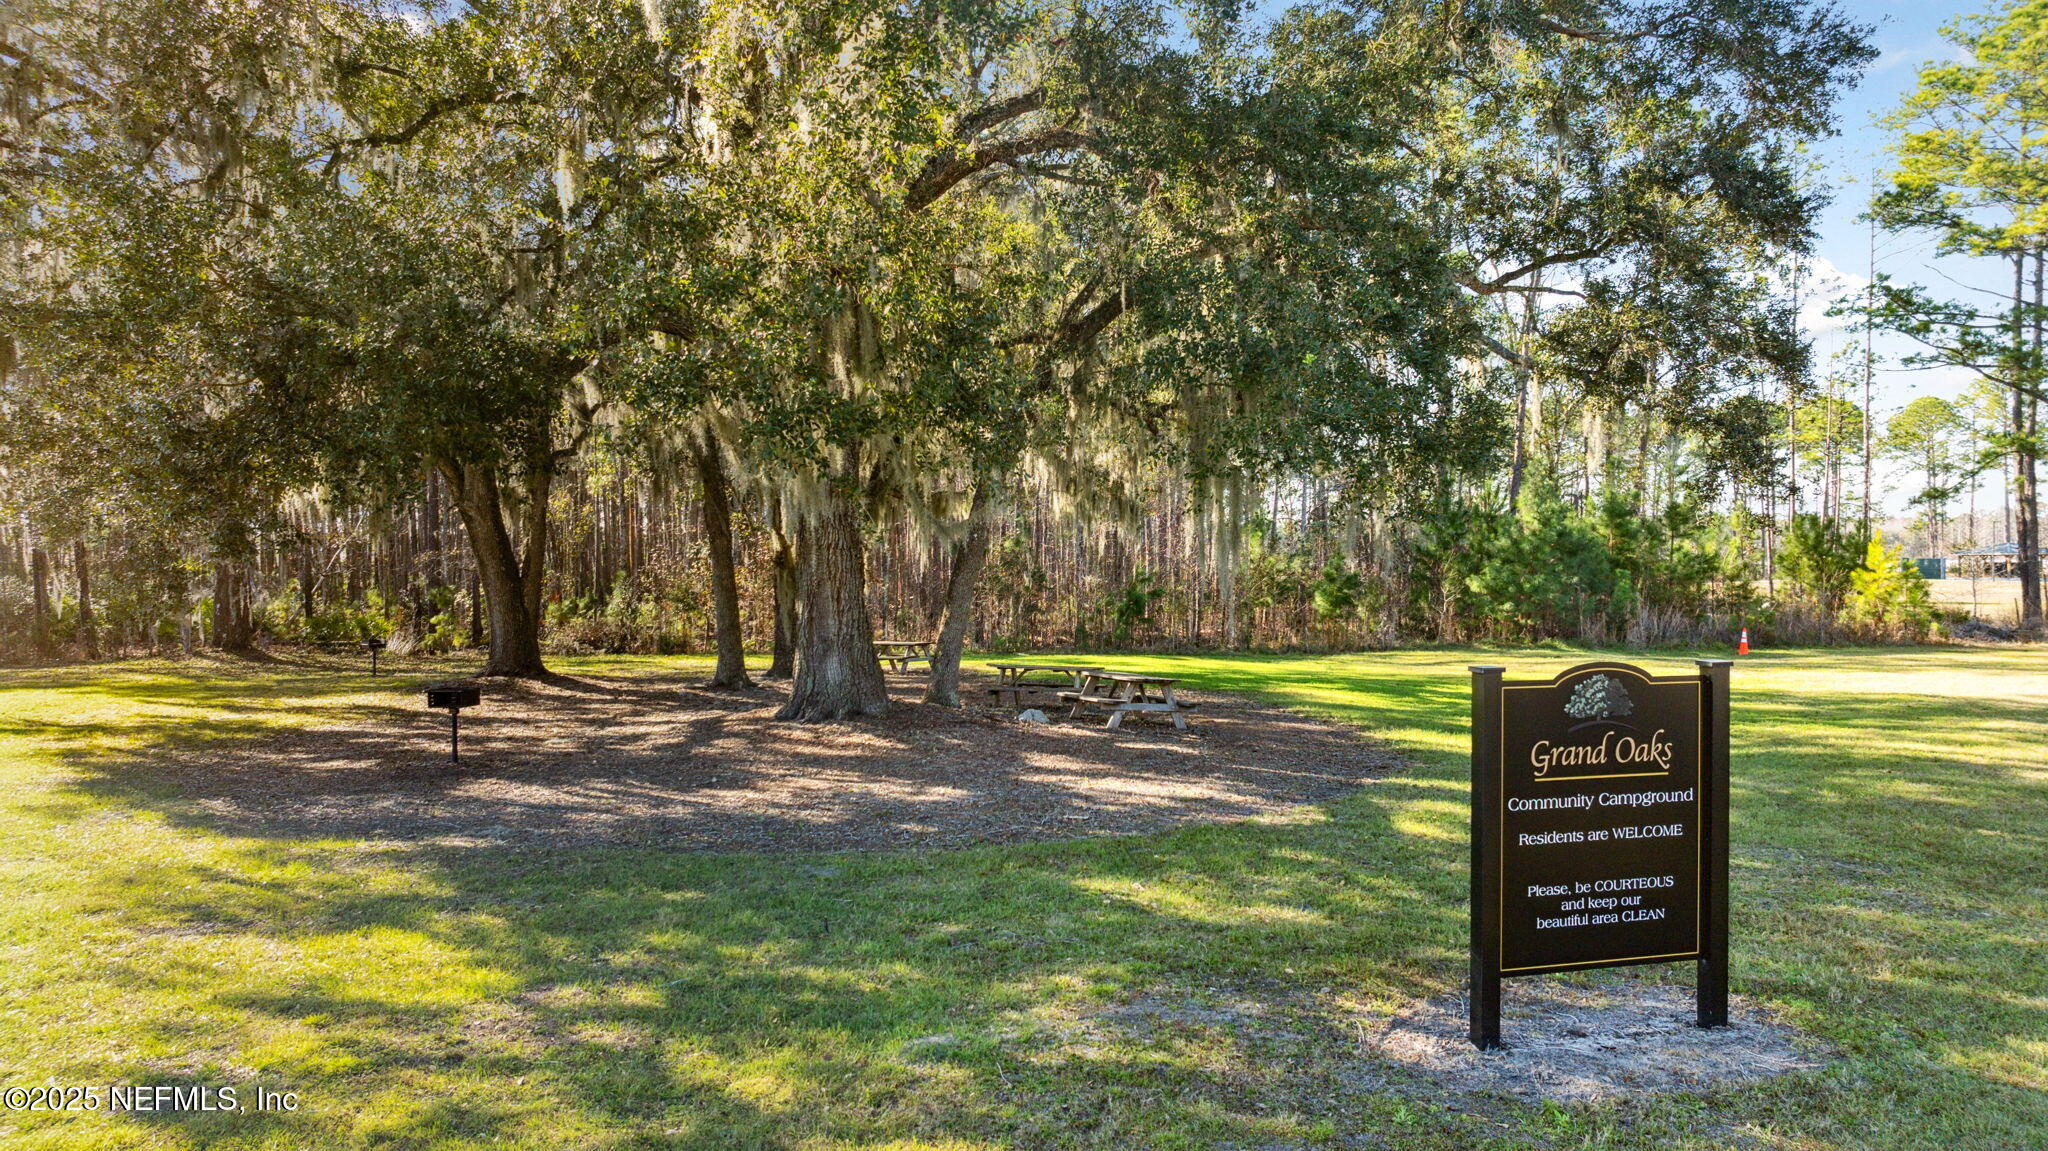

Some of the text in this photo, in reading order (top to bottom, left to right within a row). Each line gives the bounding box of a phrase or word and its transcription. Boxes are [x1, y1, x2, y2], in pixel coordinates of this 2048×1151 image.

[1531, 729, 1673, 776] Grand Oaks
[1508, 788, 1693, 812] Community Campground
[1519, 824, 1683, 846] Residents are WELCOME
[1528, 876, 1674, 897] Please, be COURTEOUS
[1561, 895, 1641, 910] and keep our
[1536, 908, 1665, 929] beautiful area CLEAN
